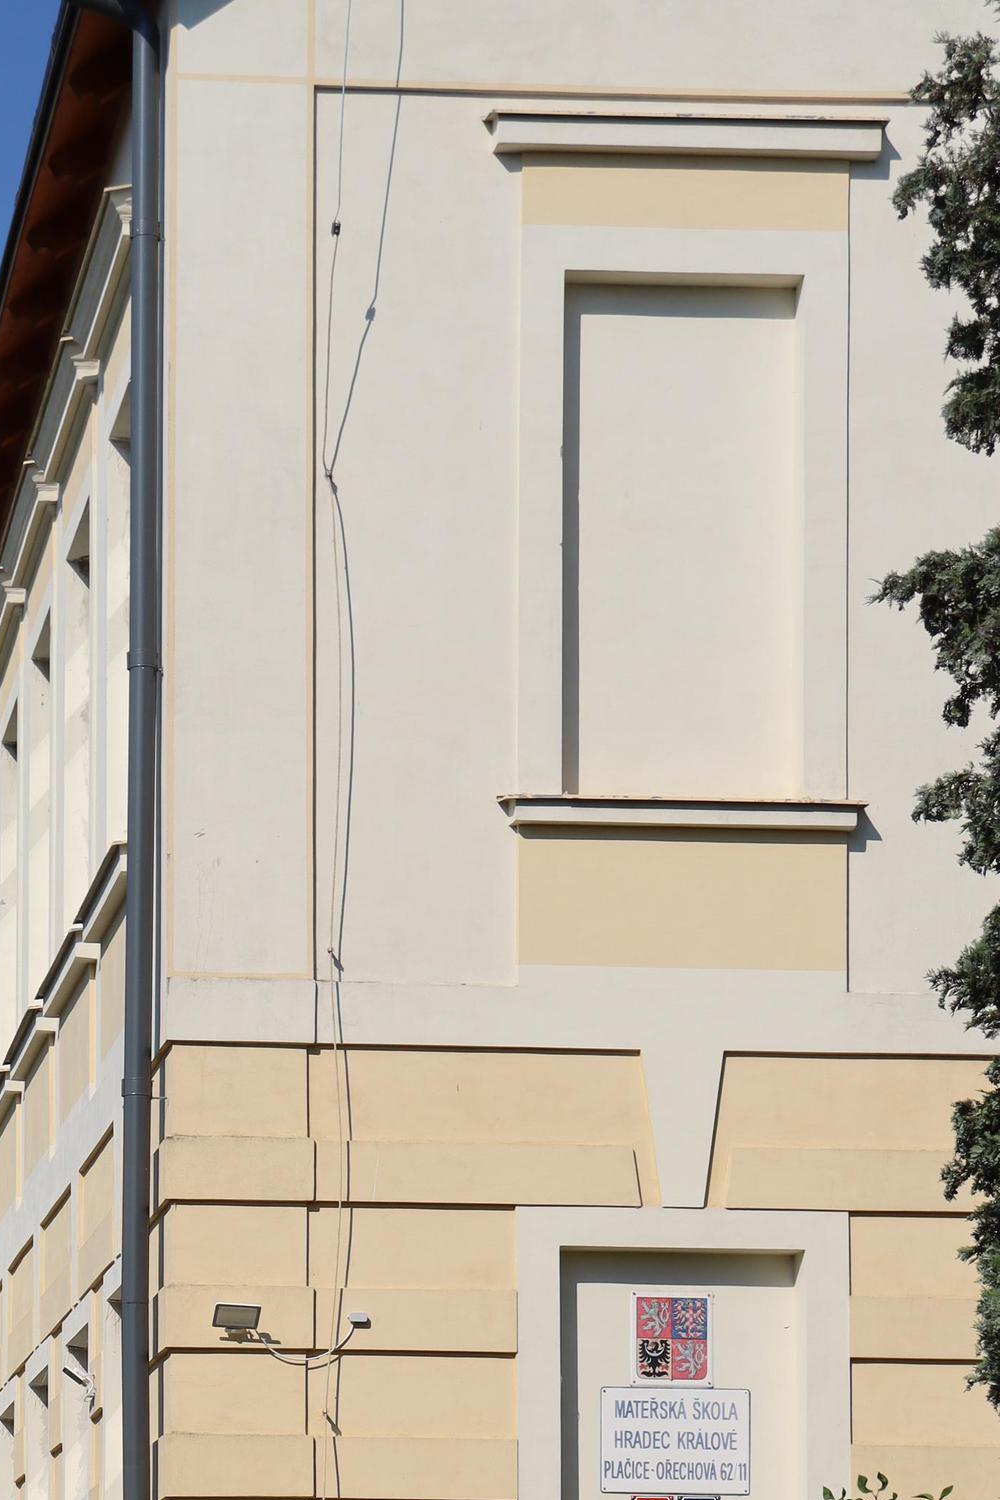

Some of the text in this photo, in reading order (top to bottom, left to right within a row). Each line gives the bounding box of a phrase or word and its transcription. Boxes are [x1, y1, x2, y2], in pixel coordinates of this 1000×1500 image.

[614, 1397, 738, 1421] MATEŘSKÁ ŠKOLA
[614, 1428, 737, 1451] HRADEC KRÁLOVÉ
